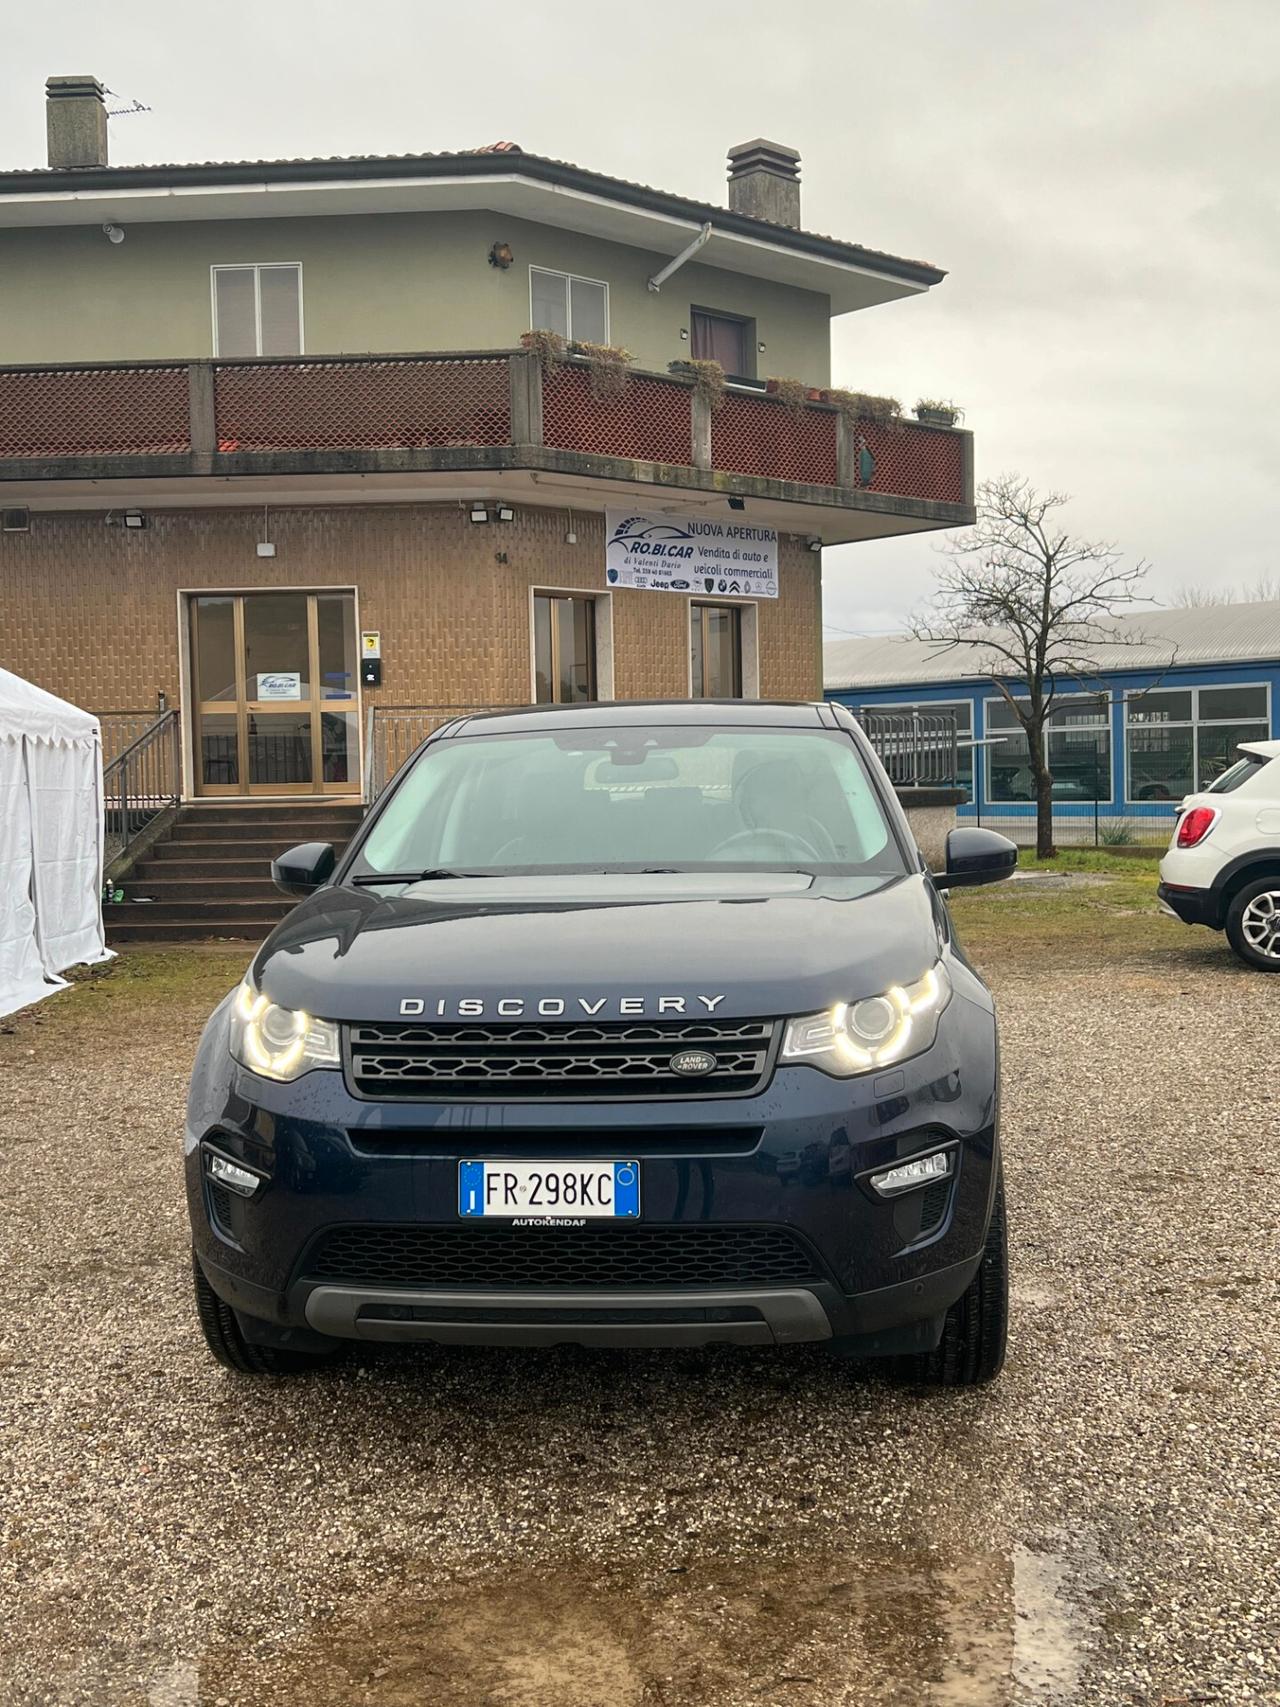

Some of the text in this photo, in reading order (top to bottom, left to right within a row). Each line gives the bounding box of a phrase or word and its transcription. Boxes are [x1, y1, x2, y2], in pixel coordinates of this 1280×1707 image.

[687, 522, 777, 542] NUOVA APERTURA
[629, 541, 694, 559] RO.BI.CAR
[697, 547, 731, 560] Vendita
[742, 553, 763, 562] auto
[634, 557, 659, 567] Valenti
[661, 560, 682, 569] Dario
[694, 565, 773, 579] veicoli commerciali
[650, 579, 670, 590] Jeep
[399, 995, 725, 1016] DISCOVERY
[528, 1172, 612, 1206] 298KC
[511, 1218, 587, 1227] AUTOKENDAF
